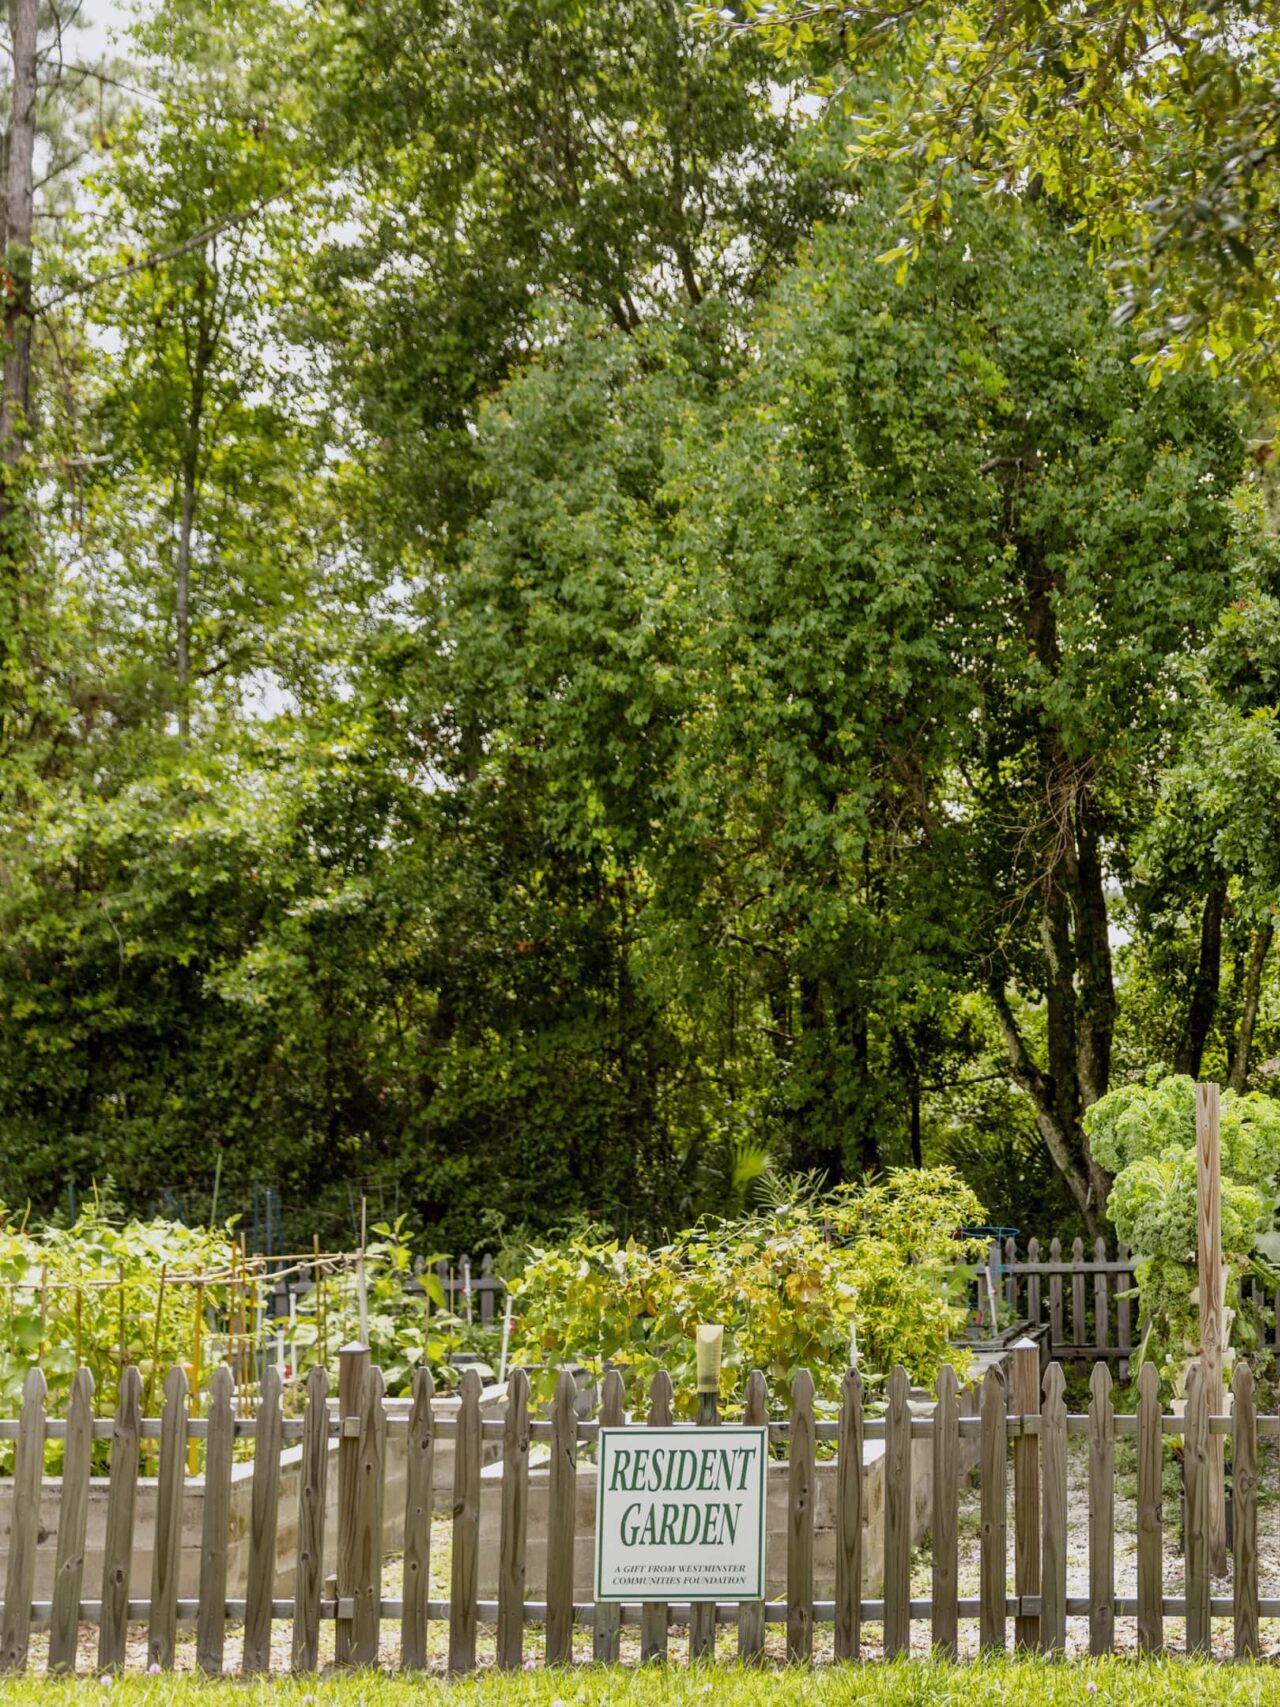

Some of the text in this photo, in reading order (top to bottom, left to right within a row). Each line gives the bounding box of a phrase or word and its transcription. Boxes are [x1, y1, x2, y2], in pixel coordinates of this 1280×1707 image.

[608, 1446, 756, 1492] RESIDENT
[620, 1503, 742, 1547] GARDEN
[612, 1576, 746, 1585] COMMUNITIES FOUNDATION
[615, 1564, 746, 1573] A GIFT FROM WESTMINSTER
